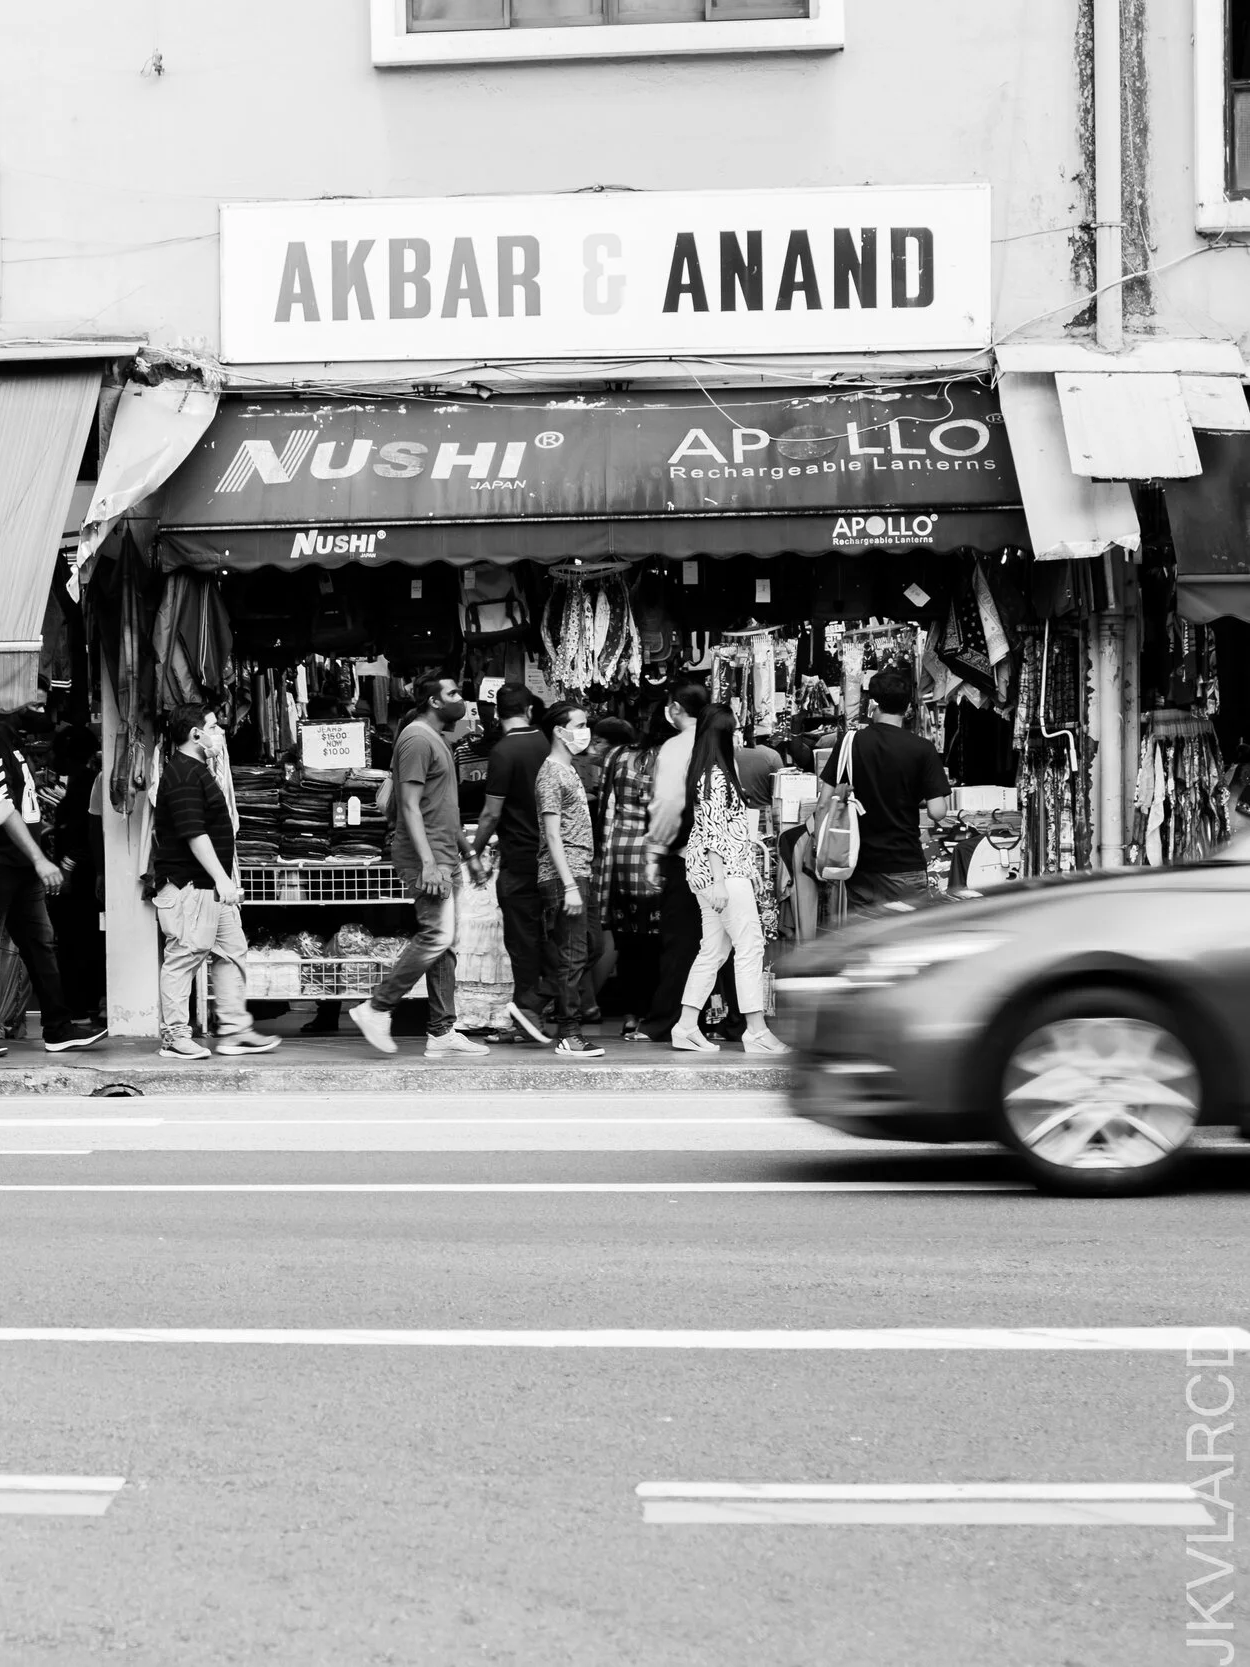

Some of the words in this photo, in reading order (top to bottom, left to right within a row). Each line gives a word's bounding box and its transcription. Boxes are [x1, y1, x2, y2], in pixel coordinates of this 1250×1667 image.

[274, 234, 542, 322] AKBAR
[581, 232, 627, 316] &
[662, 226, 936, 313] ANAND
[669, 458, 862, 480] Rechargeable
[873, 456, 996, 471] Lanterns
[470, 479, 527, 490] JAPAN
[832, 537, 893, 546] Rechargeable
[895, 536, 933, 544] Lanterns
